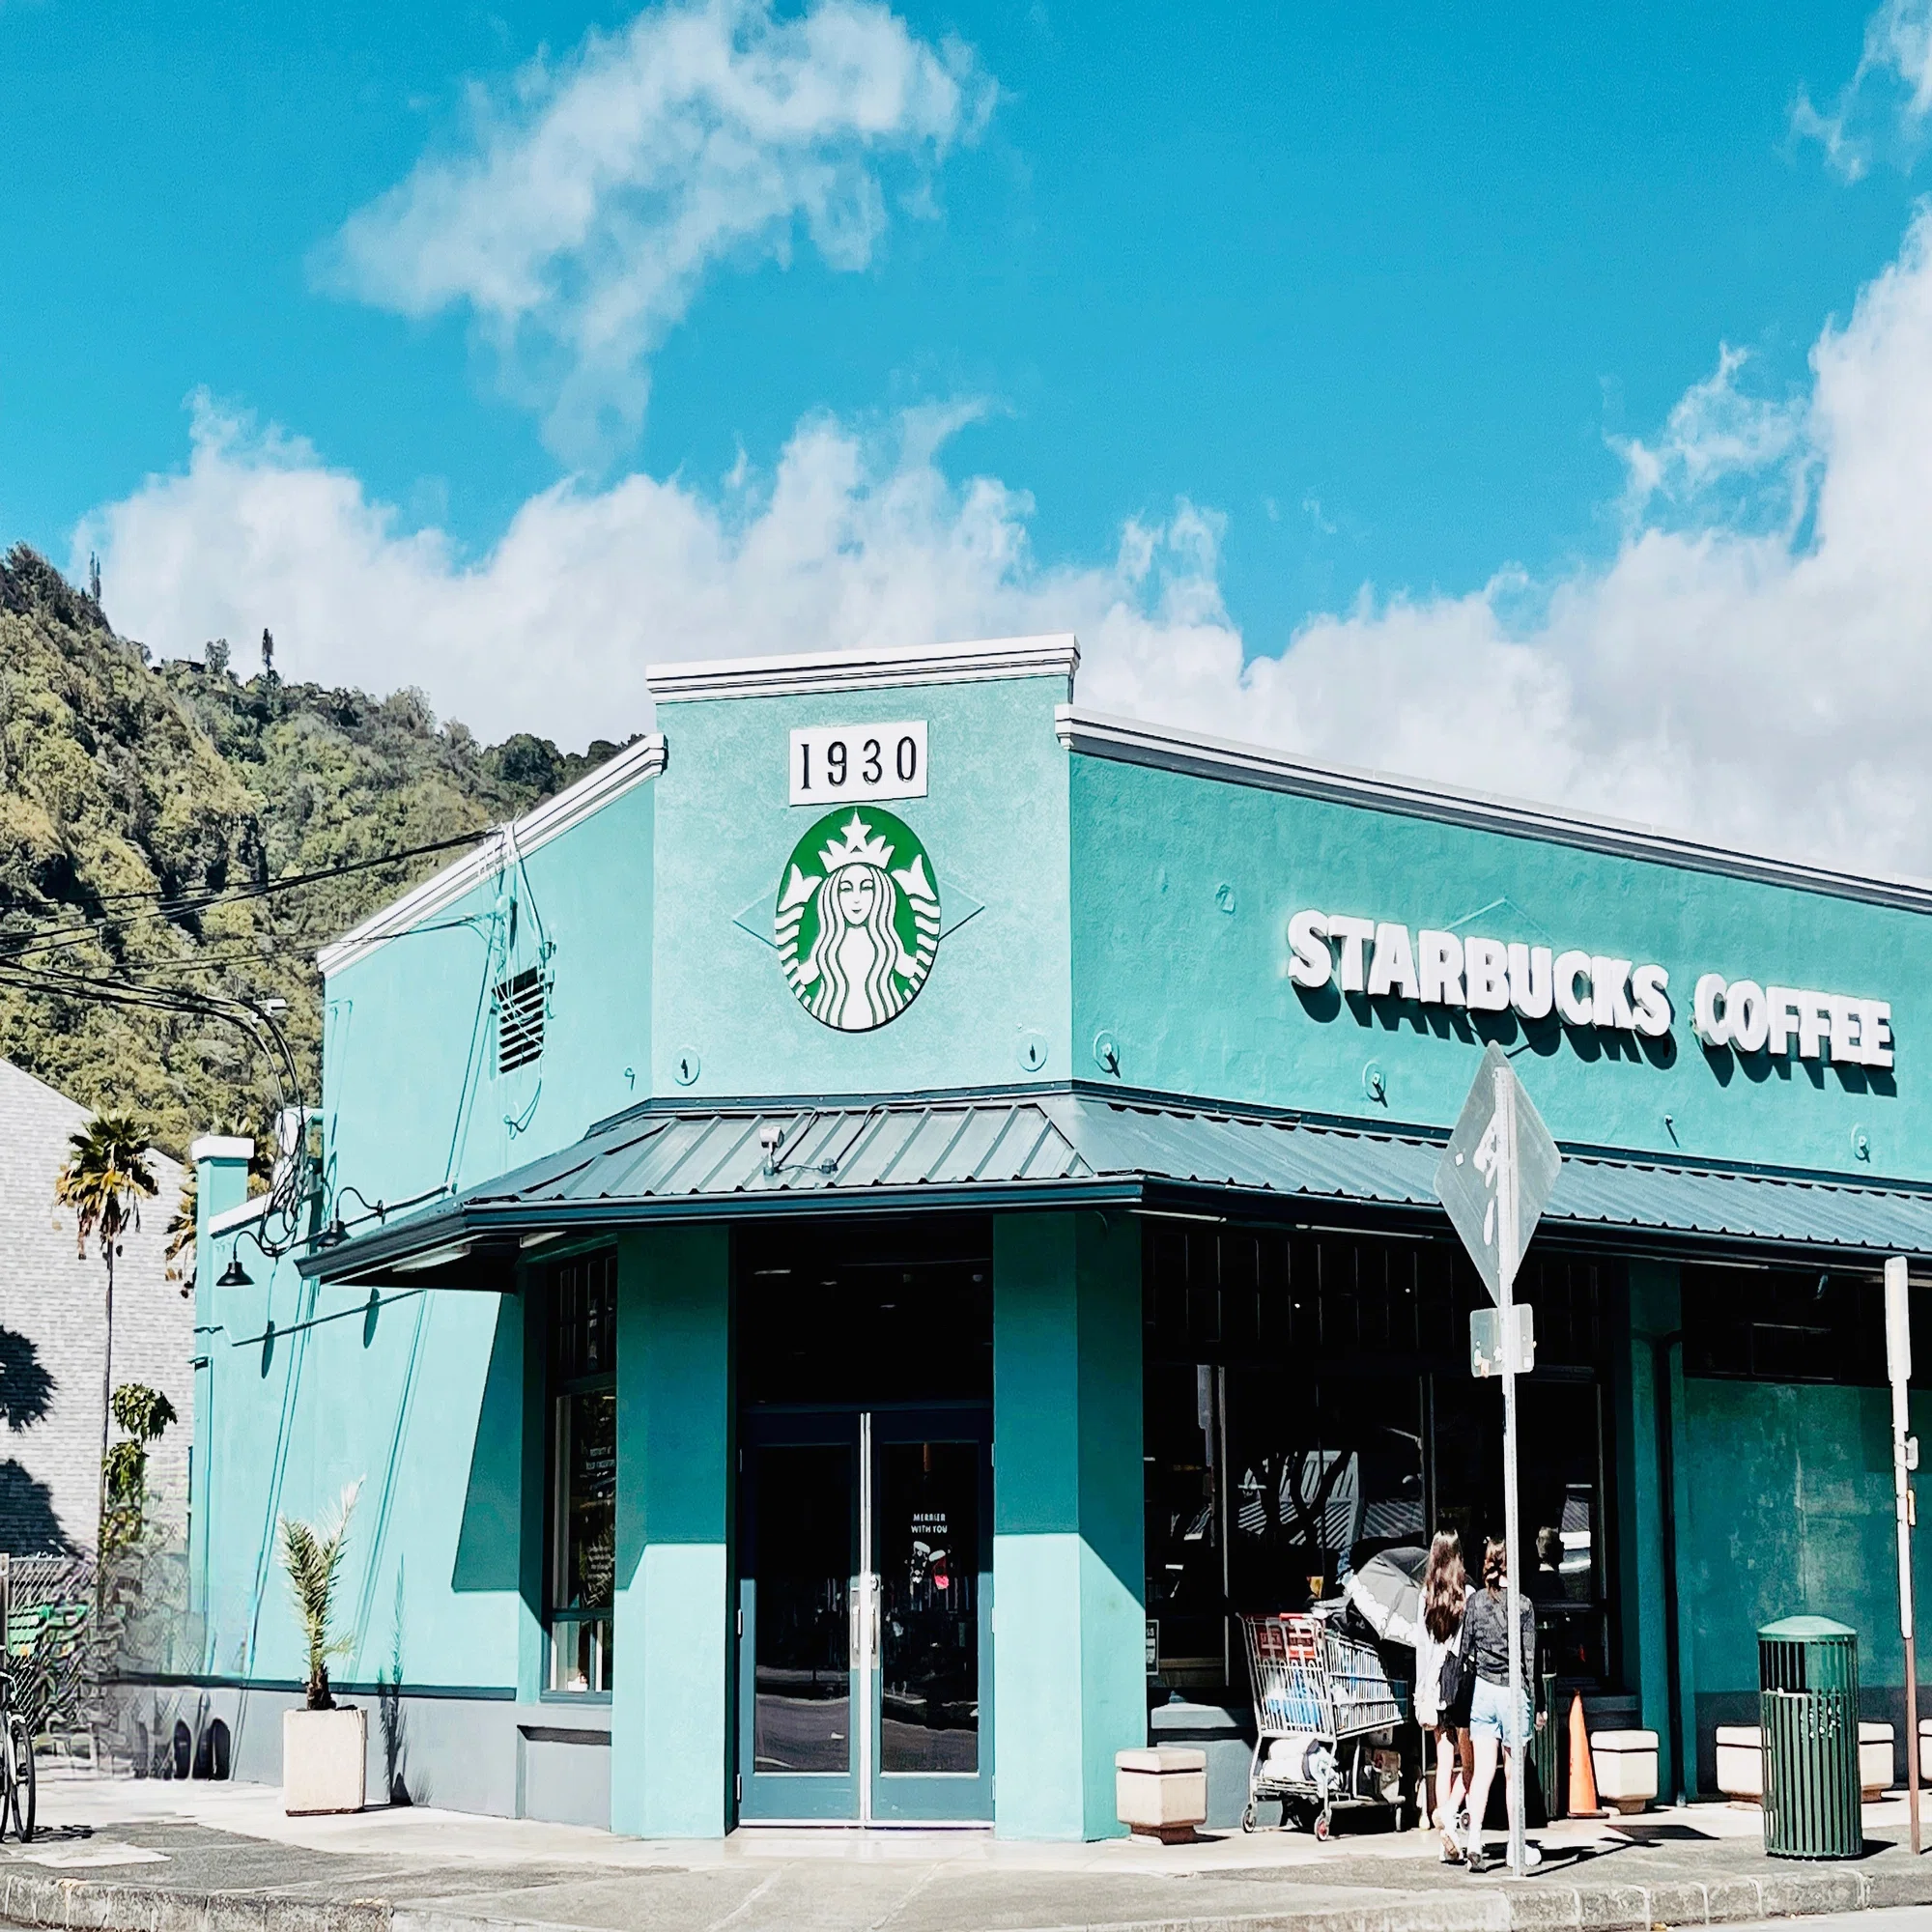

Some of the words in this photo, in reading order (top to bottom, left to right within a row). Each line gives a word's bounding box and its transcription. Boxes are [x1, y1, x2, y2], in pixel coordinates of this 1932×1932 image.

[801, 736, 917, 790] 1930
[1287, 909, 1672, 1037] STARBUCKS
[1693, 973, 1893, 1067] COFFEE
[911, 1524, 931, 1534] WITH
[932, 1524, 948, 1534] YOU
